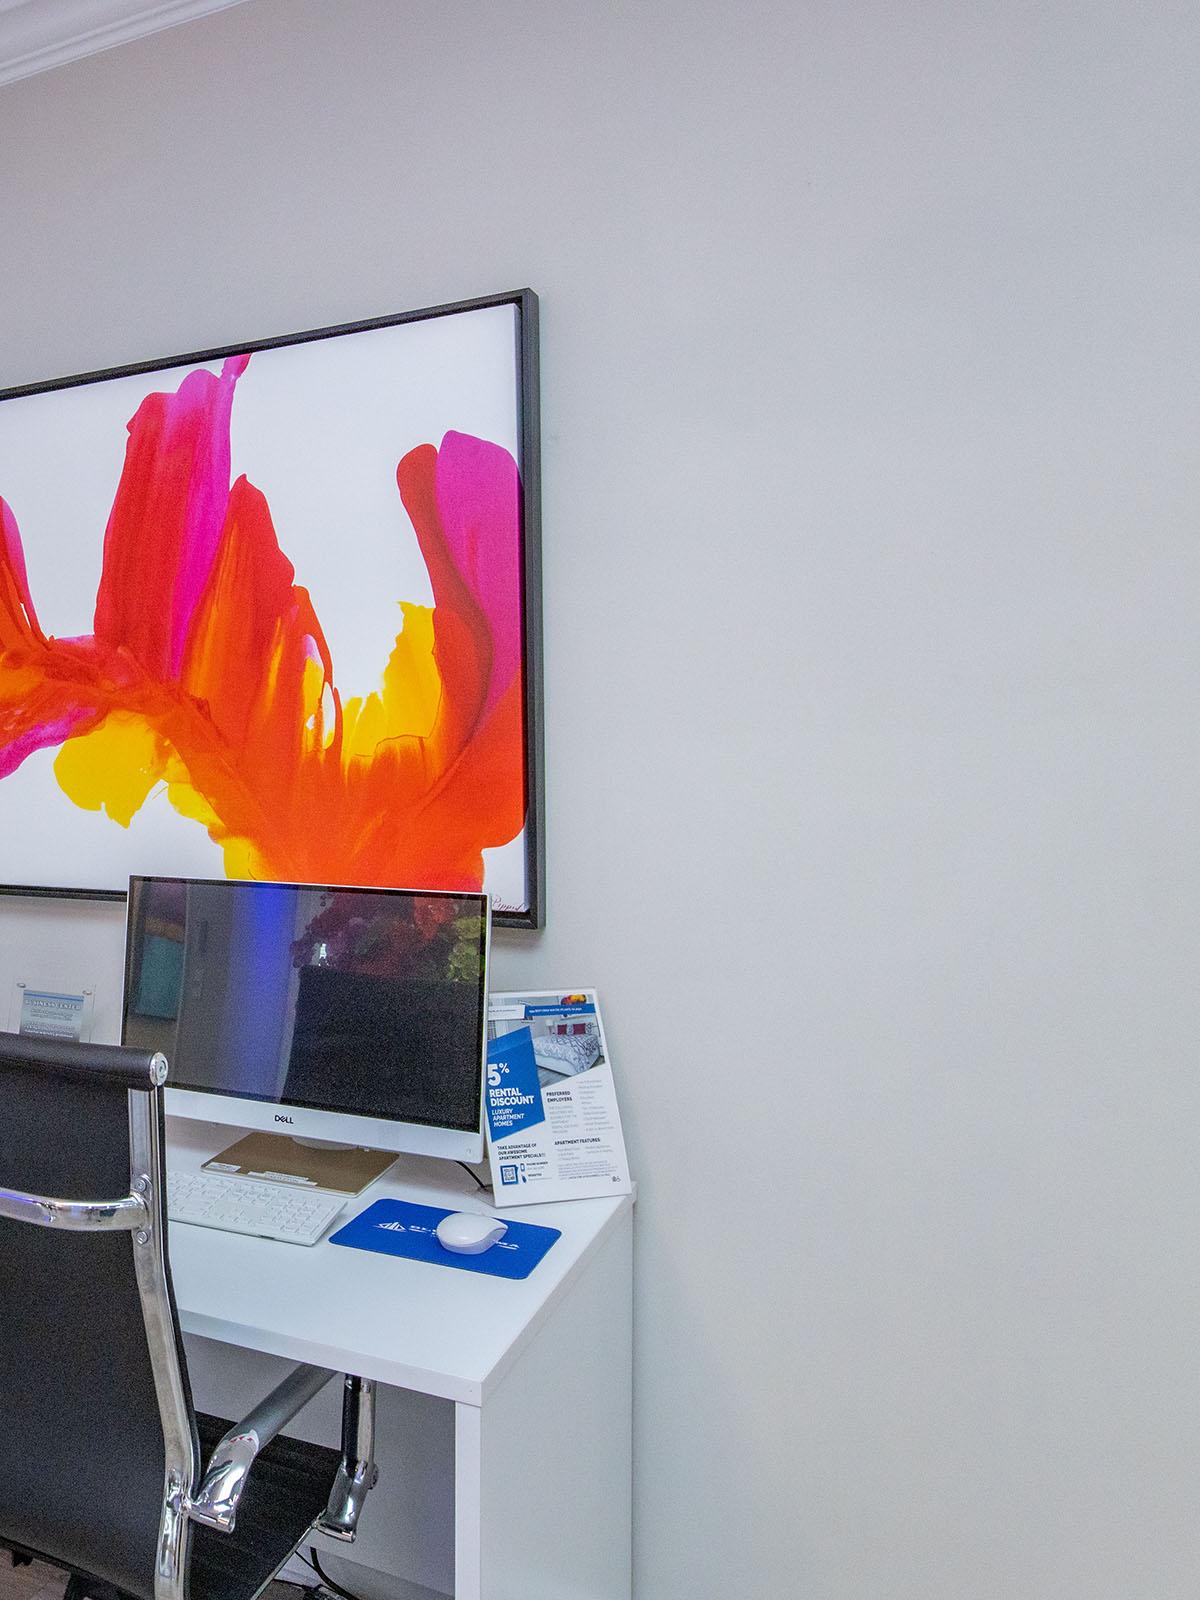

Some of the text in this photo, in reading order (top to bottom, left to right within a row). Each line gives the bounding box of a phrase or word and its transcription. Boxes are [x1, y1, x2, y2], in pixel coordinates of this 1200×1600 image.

[487, 1063, 510, 1087] 5%
[489, 1087, 522, 1098] RENTAL
[490, 1095, 535, 1107] DISCOUNT
[491, 1108, 514, 1116] LUXURY
[274, 1114, 294, 1124] DELL
[492, 1113, 525, 1122] APARTMENT
[493, 1120, 513, 1128] HOMES
